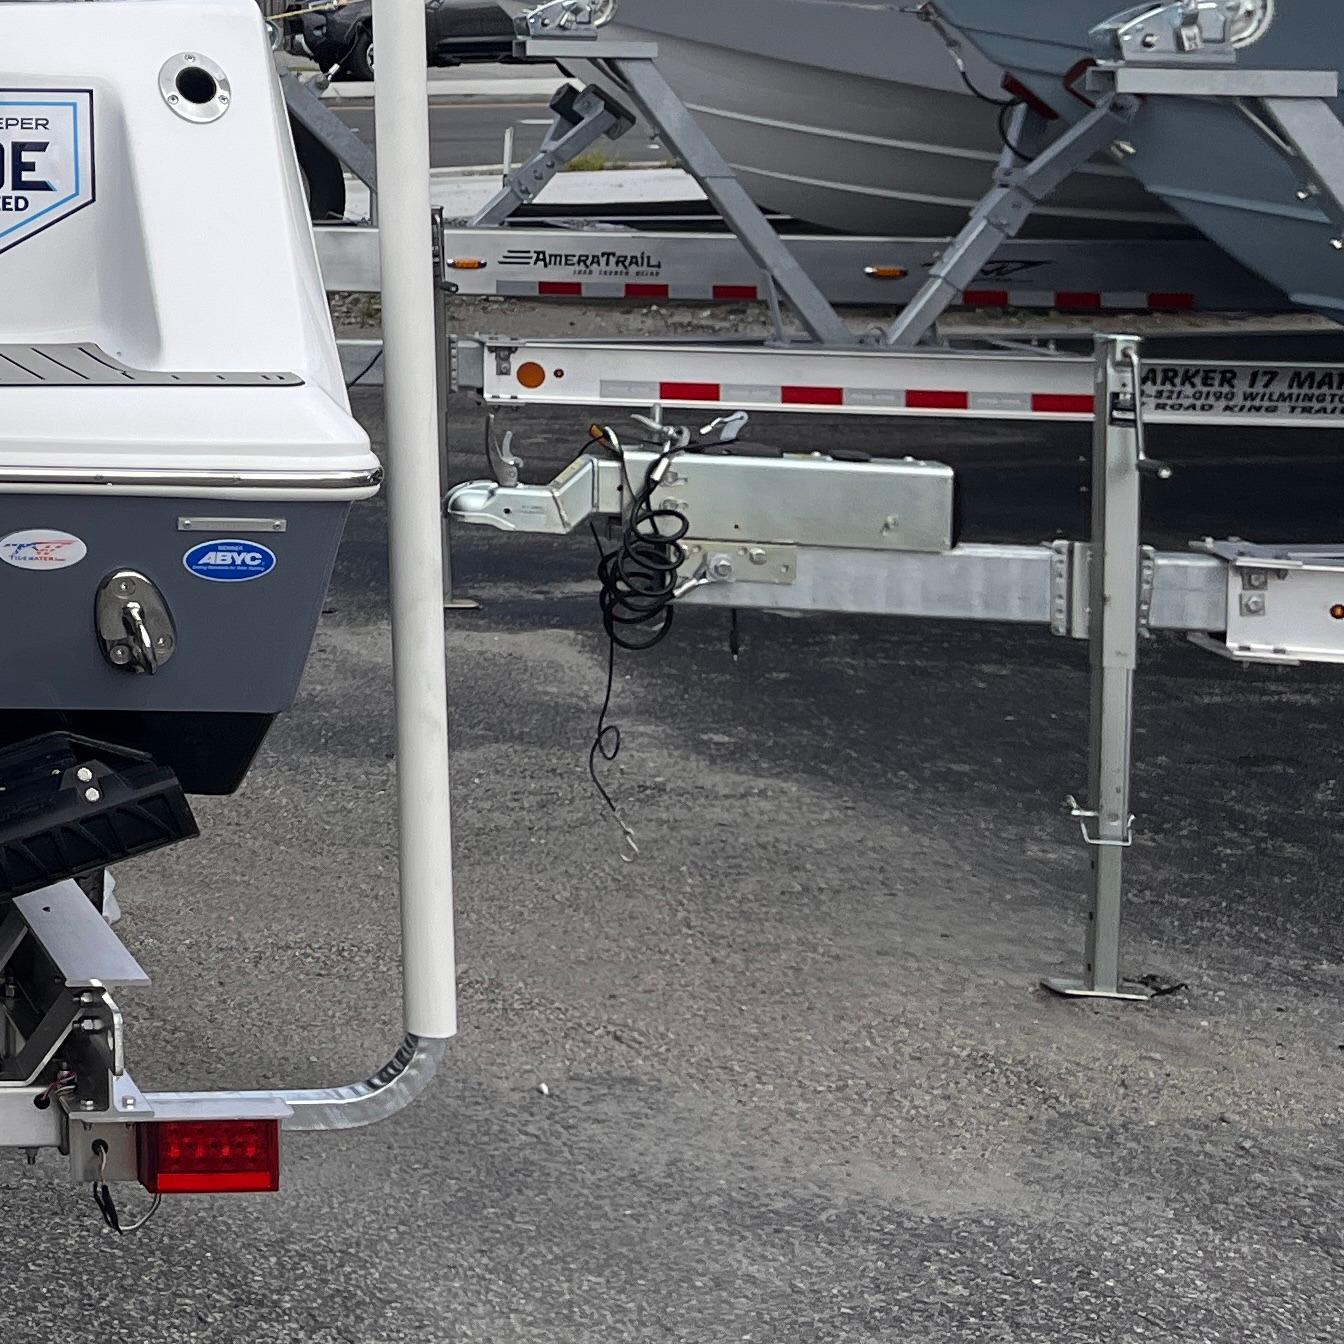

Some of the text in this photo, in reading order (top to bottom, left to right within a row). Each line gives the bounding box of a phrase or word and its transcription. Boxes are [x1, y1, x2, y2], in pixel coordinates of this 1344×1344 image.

[1141, 368, 1237, 389] ARKER
[1248, 370, 1279, 389] 17
[1154, 402, 1214, 412] ROAD
[197, 551, 263, 565] ABYC
